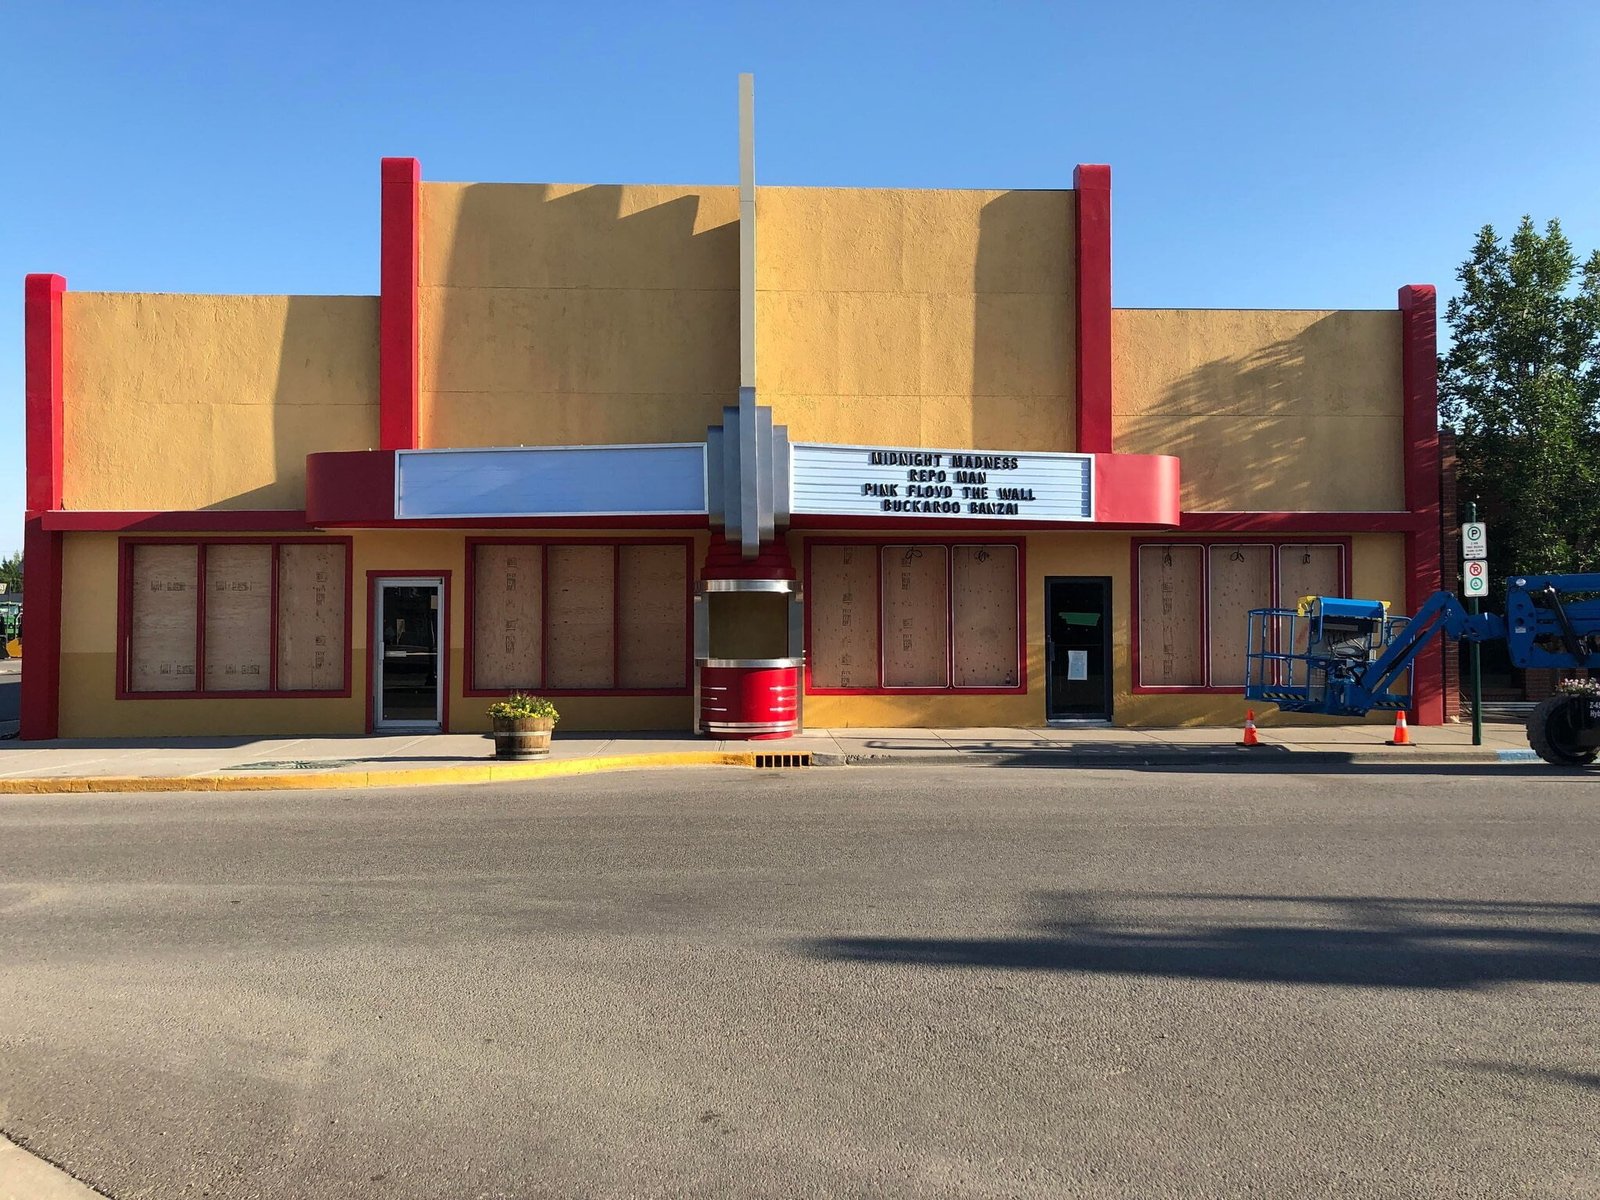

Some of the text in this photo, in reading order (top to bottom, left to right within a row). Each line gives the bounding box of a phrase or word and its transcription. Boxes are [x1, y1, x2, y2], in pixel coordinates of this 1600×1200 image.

[871, 452, 1018, 469] MIDNIGHT MADNESS
[909, 469, 987, 484] REPO MAN
[864, 483, 1036, 501] PINK FLOYD THE WALL
[883, 499, 1019, 515] BUCKAROO BANZAI
[1471, 529, 1478, 538] P
